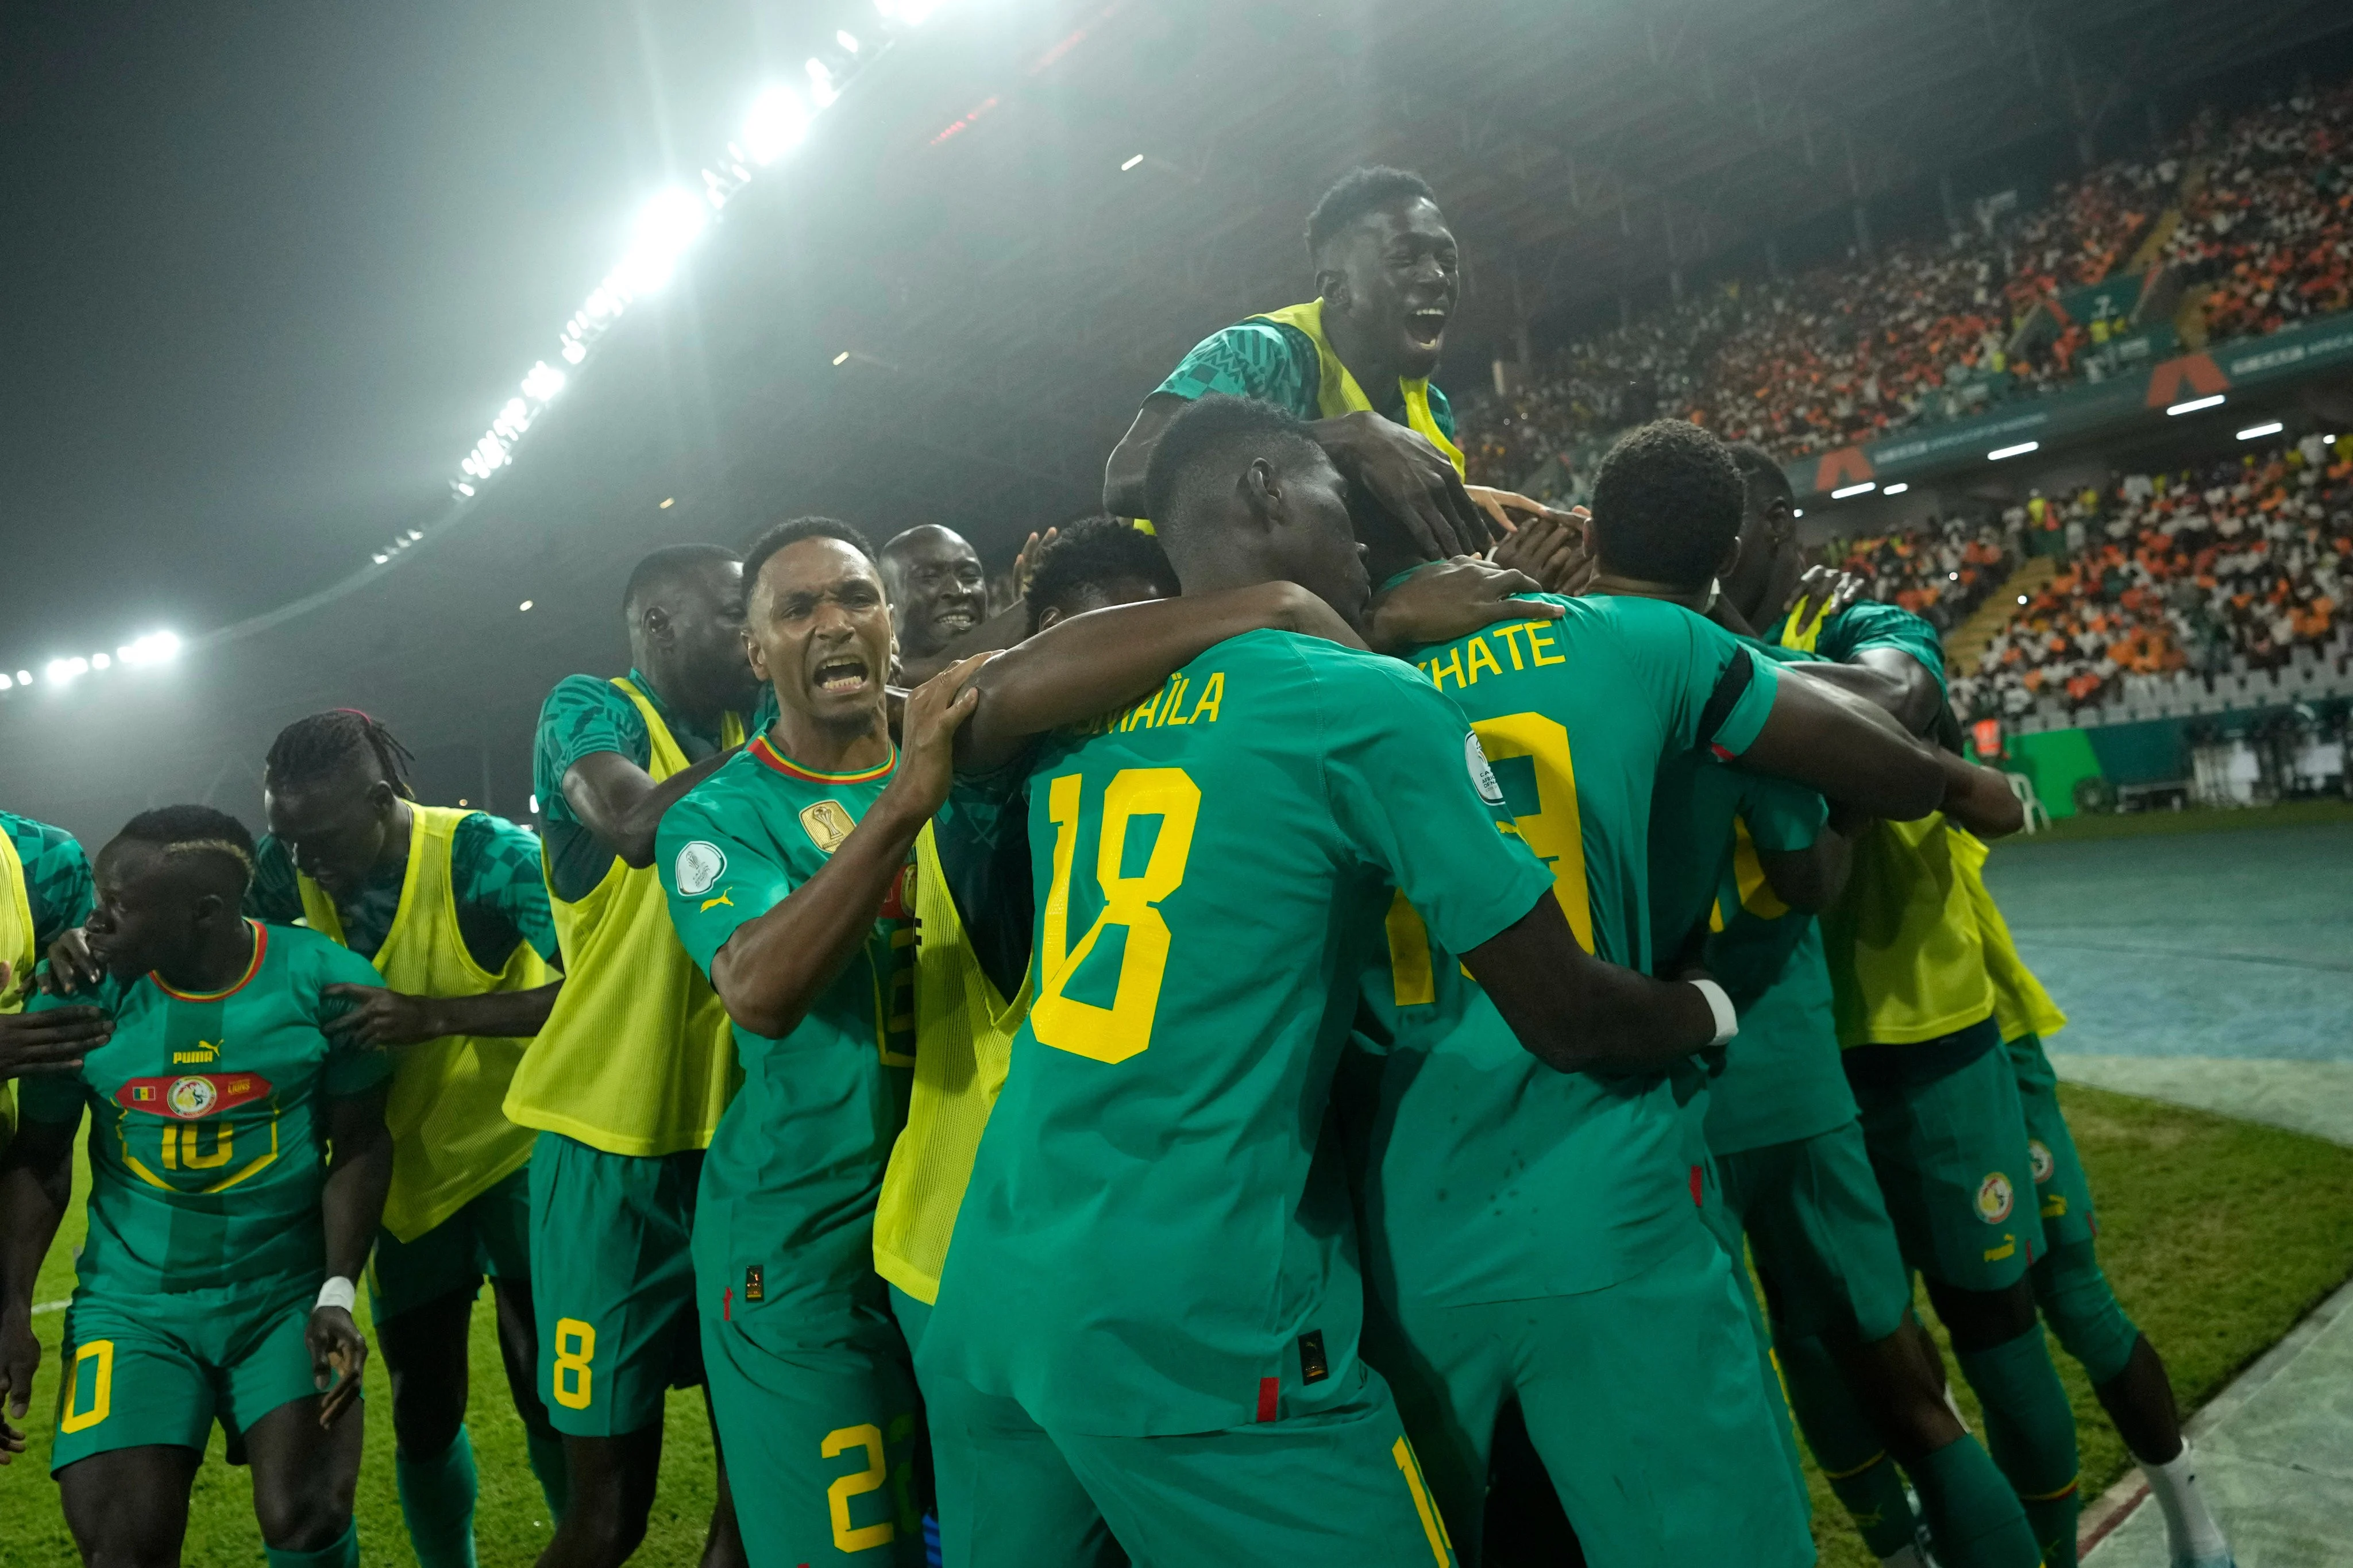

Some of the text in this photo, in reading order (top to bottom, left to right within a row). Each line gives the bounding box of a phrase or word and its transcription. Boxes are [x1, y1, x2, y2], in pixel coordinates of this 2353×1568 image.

[1417, 620, 1566, 693] HATE
[1031, 768, 1201, 1064] 18
[173, 1051, 213, 1064] PUMA
[227, 1082, 250, 1094] LIONS
[161, 1123, 233, 1170] 10
[61, 1338, 114, 1434] 0
[553, 1317, 595, 1410] 8
[1392, 1436, 1452, 1568] 1
